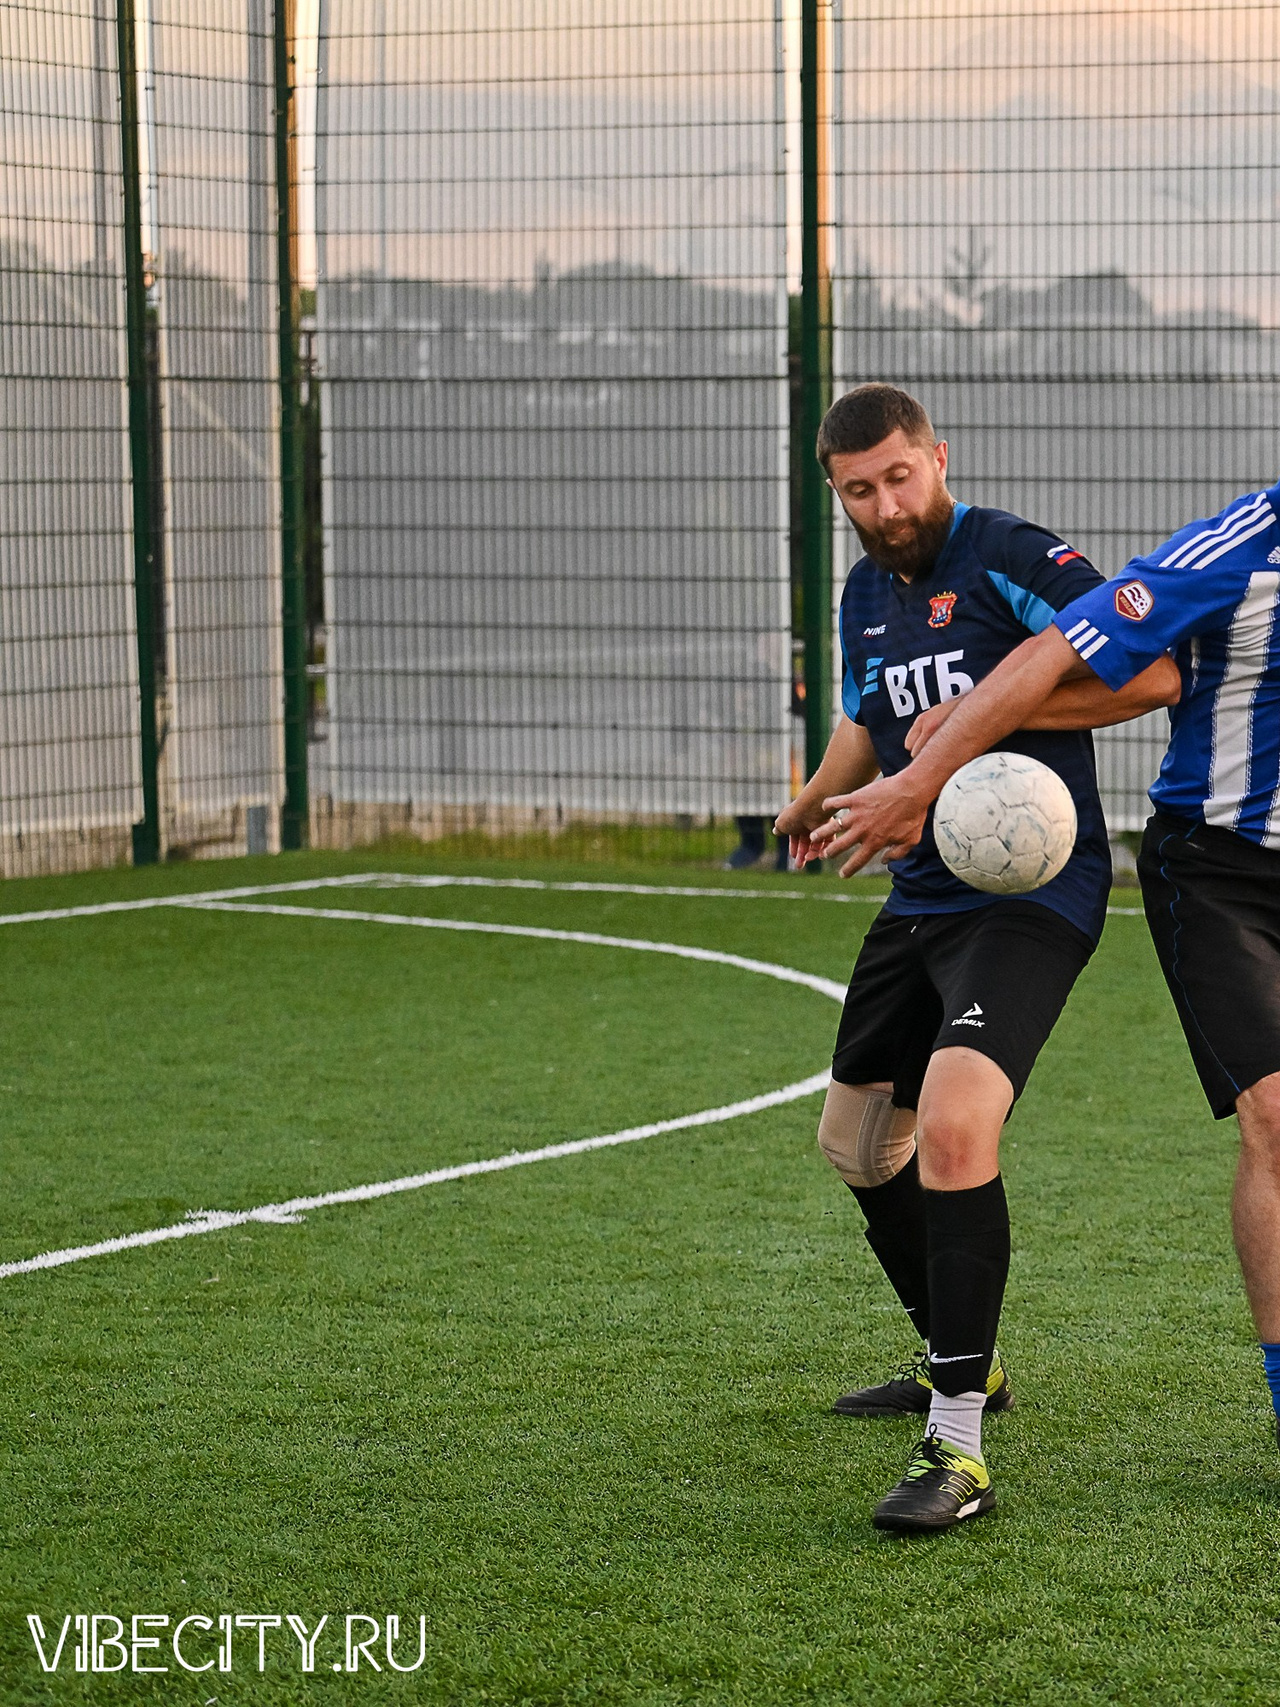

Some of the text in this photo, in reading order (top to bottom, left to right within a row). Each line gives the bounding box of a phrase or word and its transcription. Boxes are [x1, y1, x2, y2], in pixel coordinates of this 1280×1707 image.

[863, 624, 886, 635] NIKE
[885, 650, 974, 718] ВТБ
[951, 1019, 985, 1028] DEMIX
